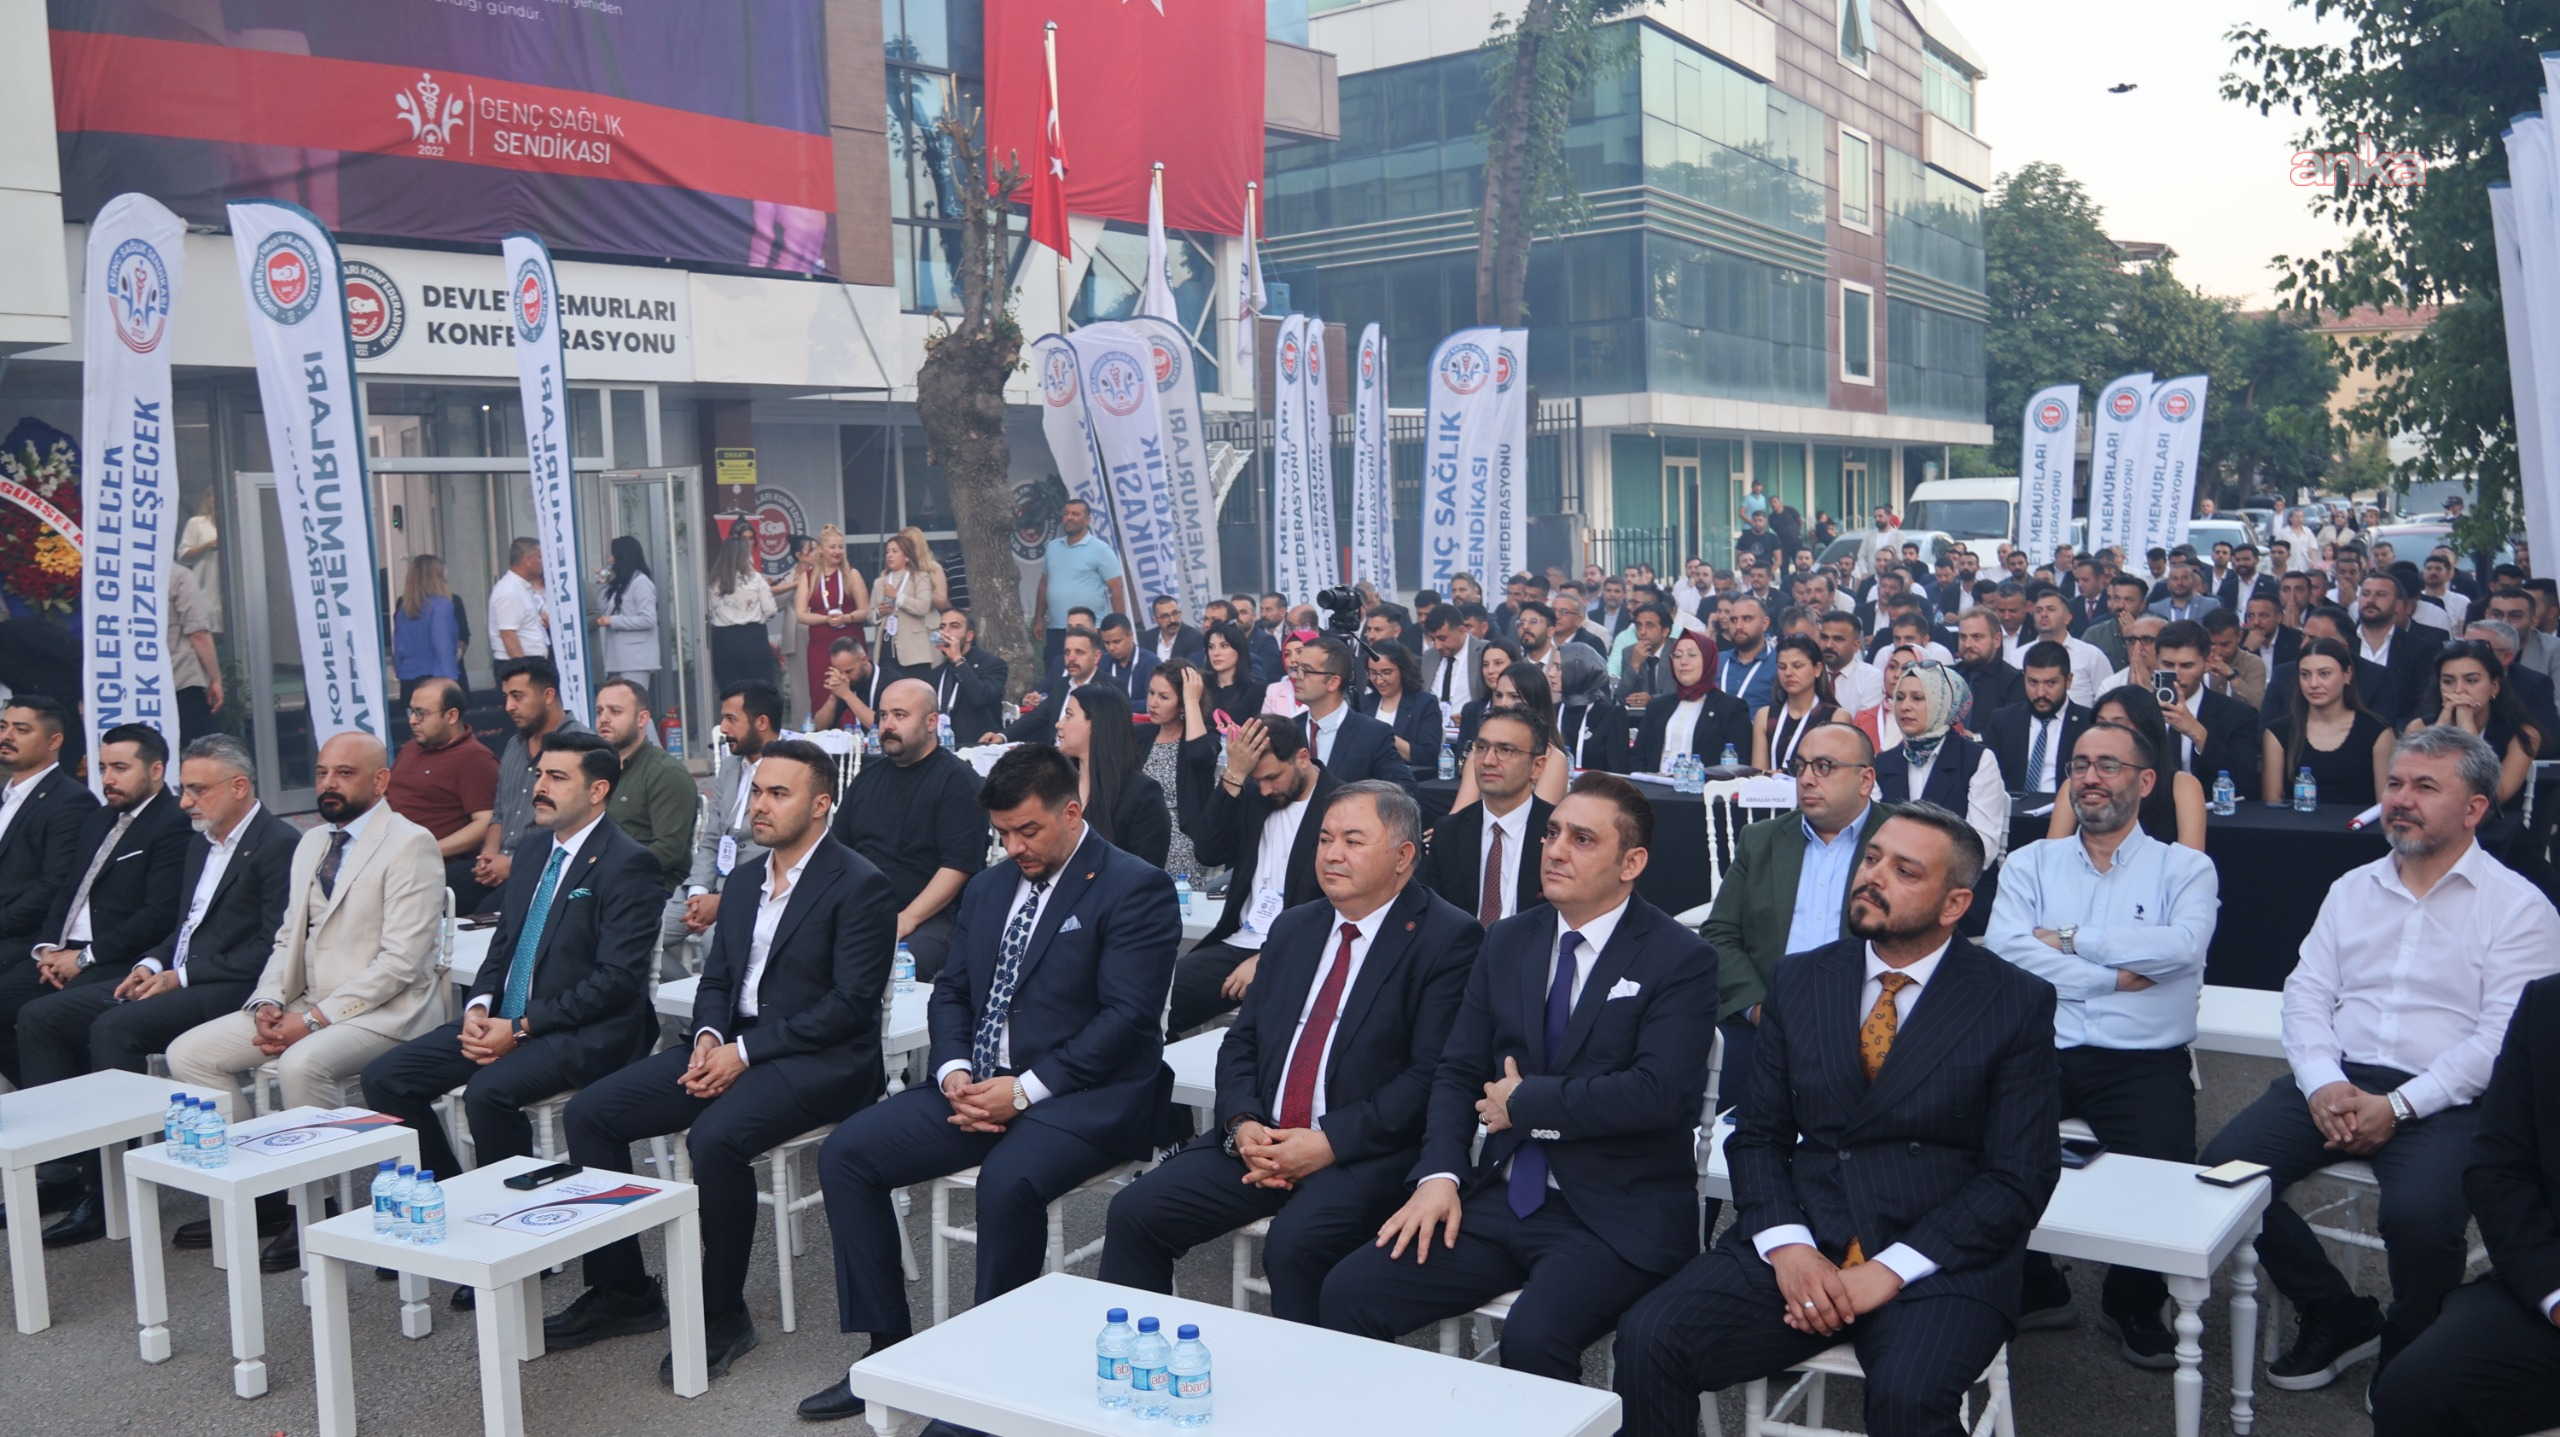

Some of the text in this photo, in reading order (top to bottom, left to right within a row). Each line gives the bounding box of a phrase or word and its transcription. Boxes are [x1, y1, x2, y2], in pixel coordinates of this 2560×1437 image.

[418, 144, 445, 156] 2022
[481, 97, 624, 137] GENÇ SAĞLIK
[494, 130, 611, 164] SENDİKASI
[422, 285, 510, 312] DEVLE
[427, 321, 676, 354] KONFERASYONU
[95, 441, 124, 603] GELECEK
[128, 396, 164, 662] GÜZELLEŞECEK
[1290, 442, 1311, 604] ONFEDERASYONU
[1431, 411, 1462, 600] ENÇ SAĞLIK
[1466, 456, 1489, 581] SENDİKASI
[2030, 443, 2048, 544] MEMURLARI
[2101, 432, 2119, 533] MEMURLARI
[2147, 432, 2171, 534] MEMURLARI
[1151, 1373, 1169, 1385] aba
